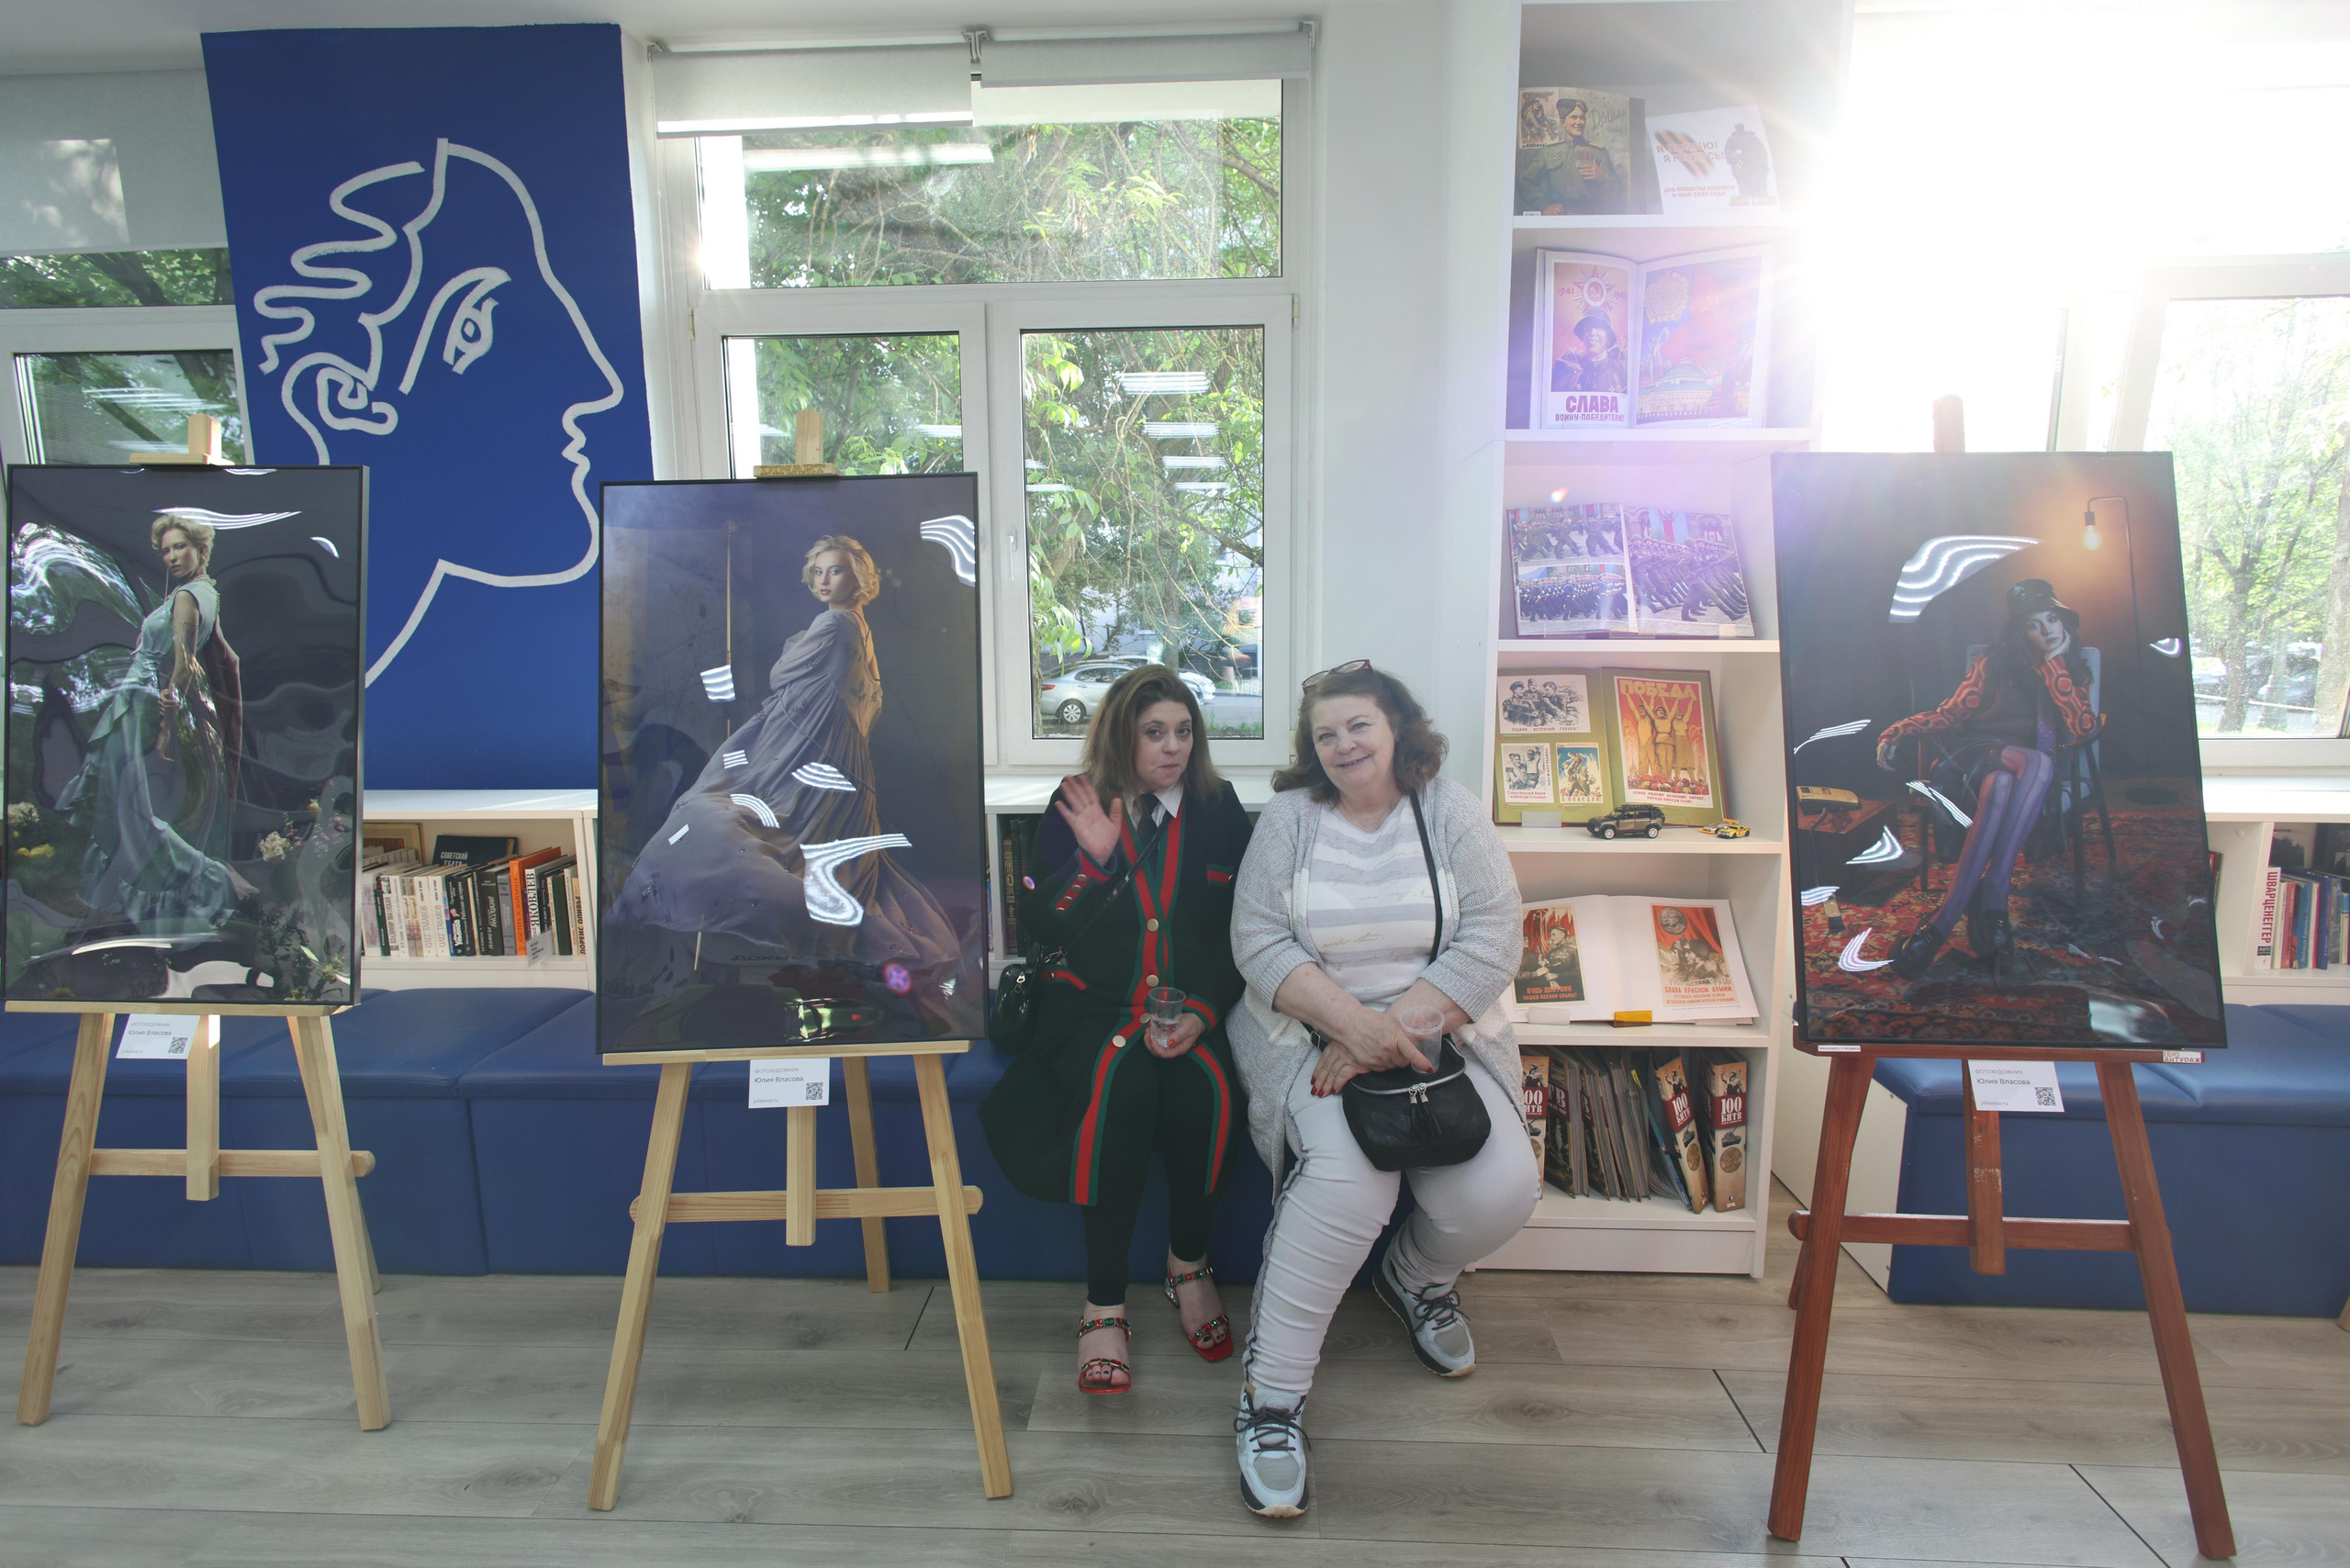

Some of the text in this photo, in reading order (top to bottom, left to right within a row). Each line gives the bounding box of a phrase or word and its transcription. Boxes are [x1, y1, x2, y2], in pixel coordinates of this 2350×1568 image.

[1669, 141, 1718, 152] ПОМНЮ!
[1674, 151, 1724, 162] ГОРЖУСЬ!
[1557, 287, 1574, 297] 1941
[1565, 396, 1618, 413] СЛАВА
[1555, 413, 1625, 421] ВОИНУ-ПОБЕДИТЕЛЮ!
[760, 464, 825, 475] DINART
[1619, 679, 1697, 701] ПОБЕДА
[441, 851, 468, 860] СОВЕТСКИЙ
[527, 873, 540, 926] ЯКОВЛЕВ
[2261, 871, 2277, 944] ШВАРЦЕНЕГГЕР
[420, 905, 430, 931] ТАБАКОВ
[435, 905, 443, 931] ТАБАКОВ
[575, 896, 587, 955] ЛОРЕНС ОЛИВЬЕ
[1544, 985, 1572, 993] ДОСТОИН
[1524, 1090, 1542, 1105] 00
[1672, 1092, 1688, 1116] 100
[1721, 1096, 1742, 1114] 100
[1525, 1104, 1542, 1113] ИТВ
[1676, 1107, 1691, 1124] БИТВ
[1721, 1112, 1742, 1123] БИТВ
